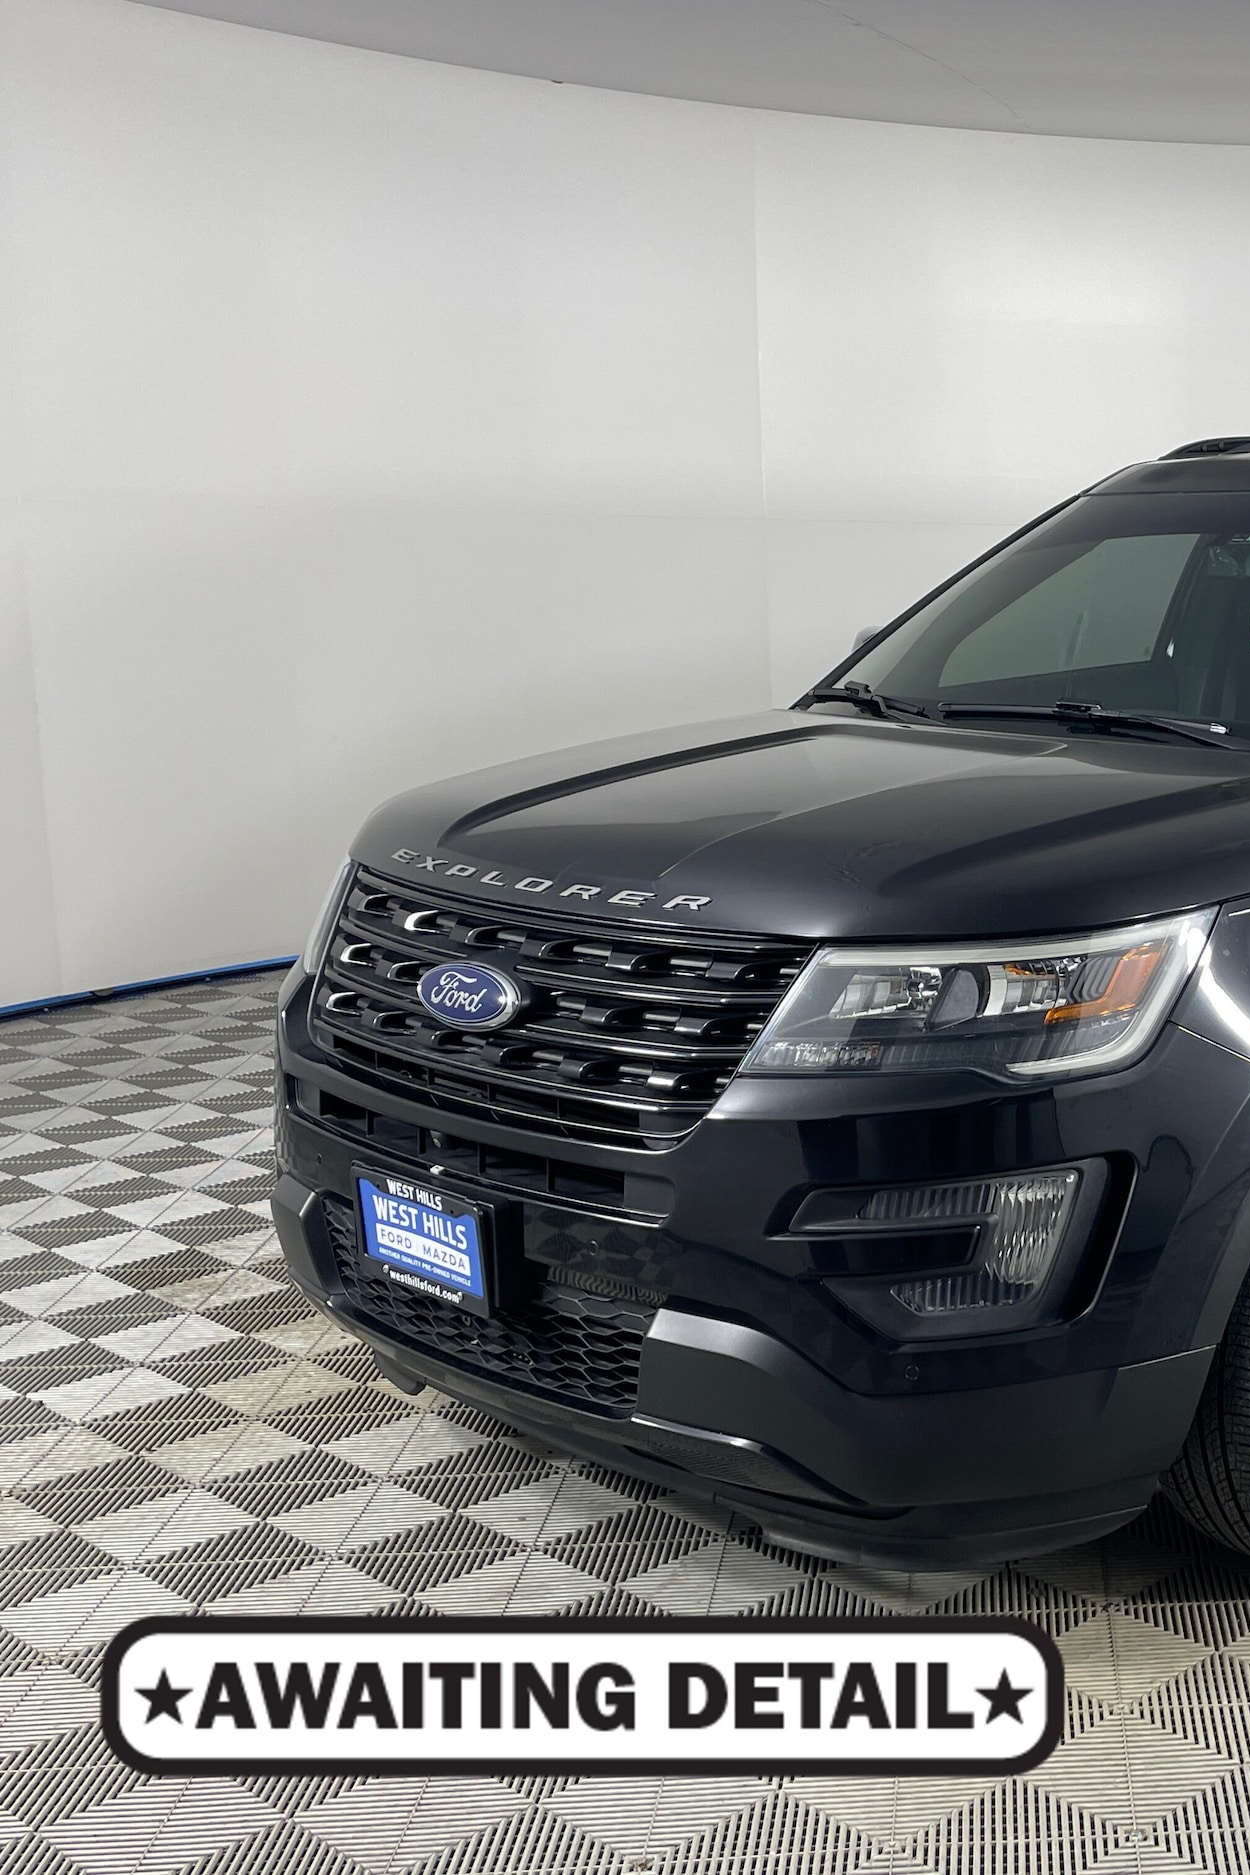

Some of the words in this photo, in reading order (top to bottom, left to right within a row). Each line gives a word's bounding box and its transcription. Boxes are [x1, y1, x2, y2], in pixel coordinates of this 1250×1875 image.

[391, 848, 713, 911] EXPLORER
[430, 971, 488, 1013] Ford
[386, 1179, 415, 1200] WEST
[416, 1189, 443, 1211] HILLS
[372, 1194, 418, 1230] WEST
[422, 1212, 468, 1250] HILLS
[381, 1228, 412, 1249] FORD
[422, 1244, 466, 1270] MAZDA
[389, 1270, 460, 1304] westhillsford.com
